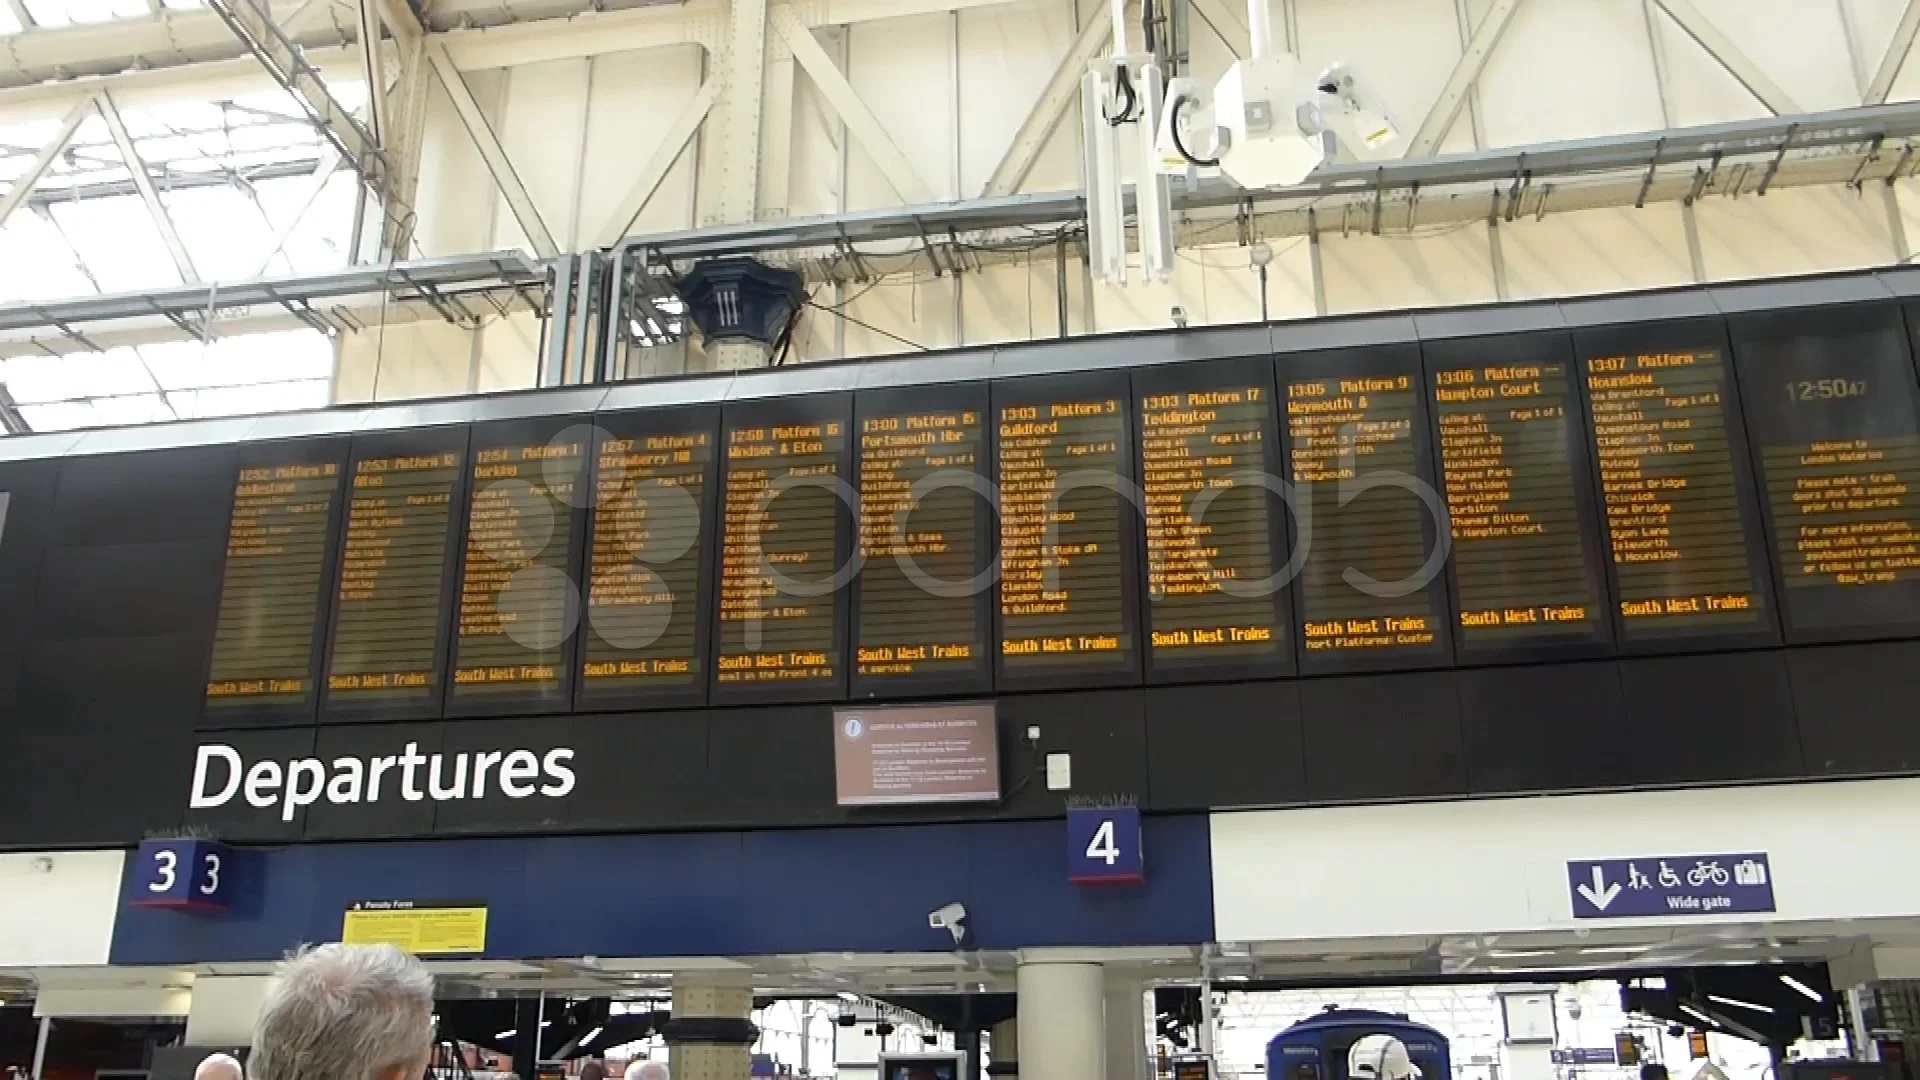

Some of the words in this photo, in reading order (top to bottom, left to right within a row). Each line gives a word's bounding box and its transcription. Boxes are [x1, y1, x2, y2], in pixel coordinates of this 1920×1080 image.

[1587, 357, 1626, 372] 13:07
[1636, 351, 1694, 368] Platform
[1484, 364, 1539, 380] Platform
[1588, 372, 1652, 388] Hounslow
[1340, 377, 1394, 393] Platform
[1436, 385, 1494, 402] Hampton
[1499, 382, 1540, 396] Court
[1786, 379, 1847, 400] 12:50
[1143, 395, 1179, 409] 13:03
[1188, 390, 1240, 405] Platform
[1287, 397, 1352, 414] Weymouth
[1001, 405, 1036, 420] 13:03
[1051, 401, 1100, 416] Platform
[1142, 408, 1216, 427] Teddington
[772, 422, 820, 440] Platform
[863, 417, 897, 432] 13:00
[906, 413, 955, 429] Platform
[999, 420, 1057, 436] Guildford
[647, 433, 693, 449] Platform
[793, 439, 822, 454] Eton
[862, 431, 935, 448] Portsmouth
[522, 444, 567, 459] Platform
[274, 464, 319, 478] Platform
[394, 455, 438, 469] Platform
[1621, 599, 1661, 615] South
[1665, 597, 1699, 612] West
[1705, 594, 1748, 610] Trains
[1460, 610, 1499, 625] South
[1504, 608, 1536, 623] West
[1542, 606, 1584, 621] Trains
[1304, 620, 1343, 636] South
[1347, 619, 1379, 634] West
[1384, 616, 1424, 632] Trains
[1002, 640, 1037, 654] South
[1043, 638, 1072, 653] West
[1078, 636, 1117, 651] Trains
[1151, 631, 1188, 646] South
[1193, 629, 1223, 643] West
[1230, 626, 1270, 641] Trains
[719, 656, 751, 670] South
[755, 654, 783, 668] West
[790, 652, 826, 666] Trains
[858, 647, 892, 661] South
[897, 645, 925, 660] West
[932, 643, 969, 658] Trains
[455, 668, 486, 682] South
[489, 666, 514, 680] West
[520, 664, 552, 678] Trains
[583, 662, 616, 676] South
[620, 660, 646, 674] West
[652, 658, 688, 673] Trains
[206, 681, 236, 695] South
[239, 679, 264, 693] West
[268, 677, 301, 691] Trains
[328, 676, 359, 690] South
[362, 674, 388, 688] West
[393, 672, 426, 686] Trains
[190, 742, 576, 822] Departures
[1086, 821, 1120, 864] 4
[148, 850, 177, 892] 3
[200, 854, 220, 895] 3
[1667, 896, 1699, 909] Wide
[1702, 896, 1731, 910] gate
